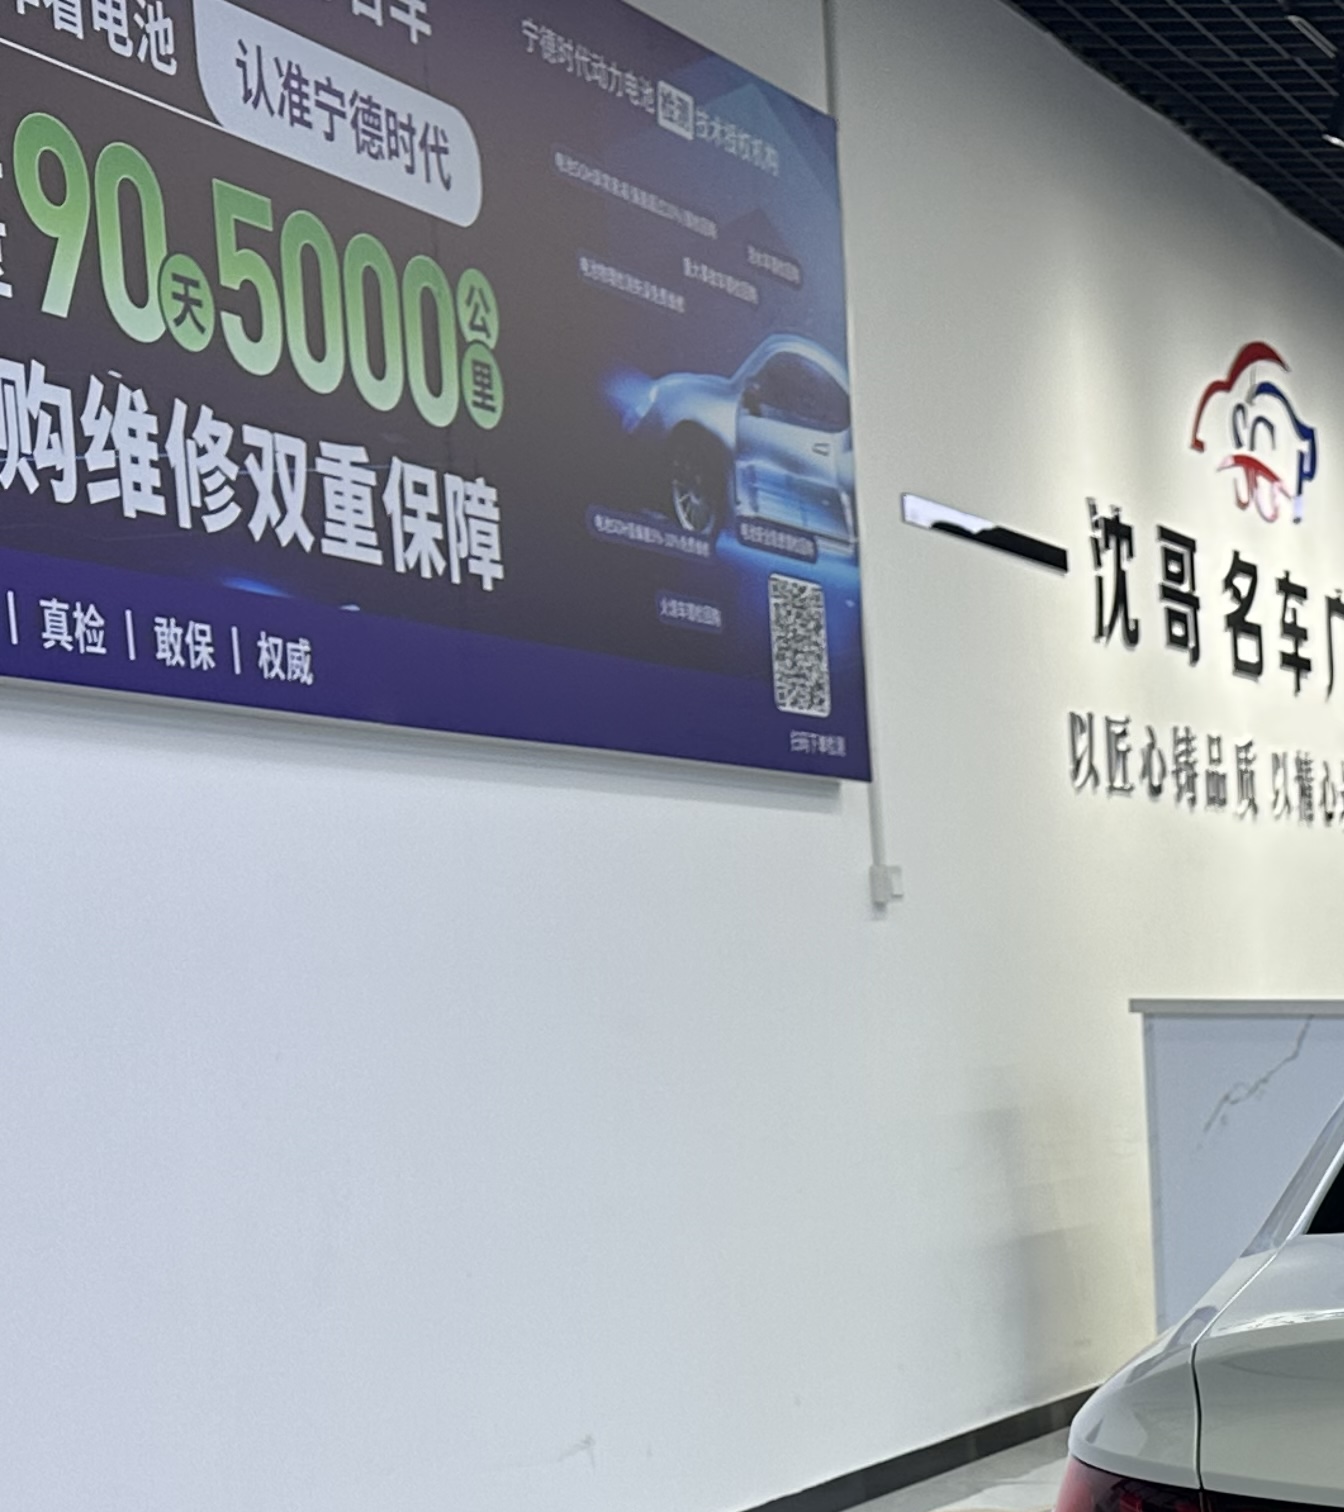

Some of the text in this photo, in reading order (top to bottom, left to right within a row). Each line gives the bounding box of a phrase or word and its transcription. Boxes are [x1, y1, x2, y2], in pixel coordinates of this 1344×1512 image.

[235, 39, 453, 192] 认准宁德时代
[0, 358, 505, 592] 购维修双重保障
[39, 597, 314, 686] 真检 敢保 权威
[1068, 710, 1259, 820] 以匠心铸品质
